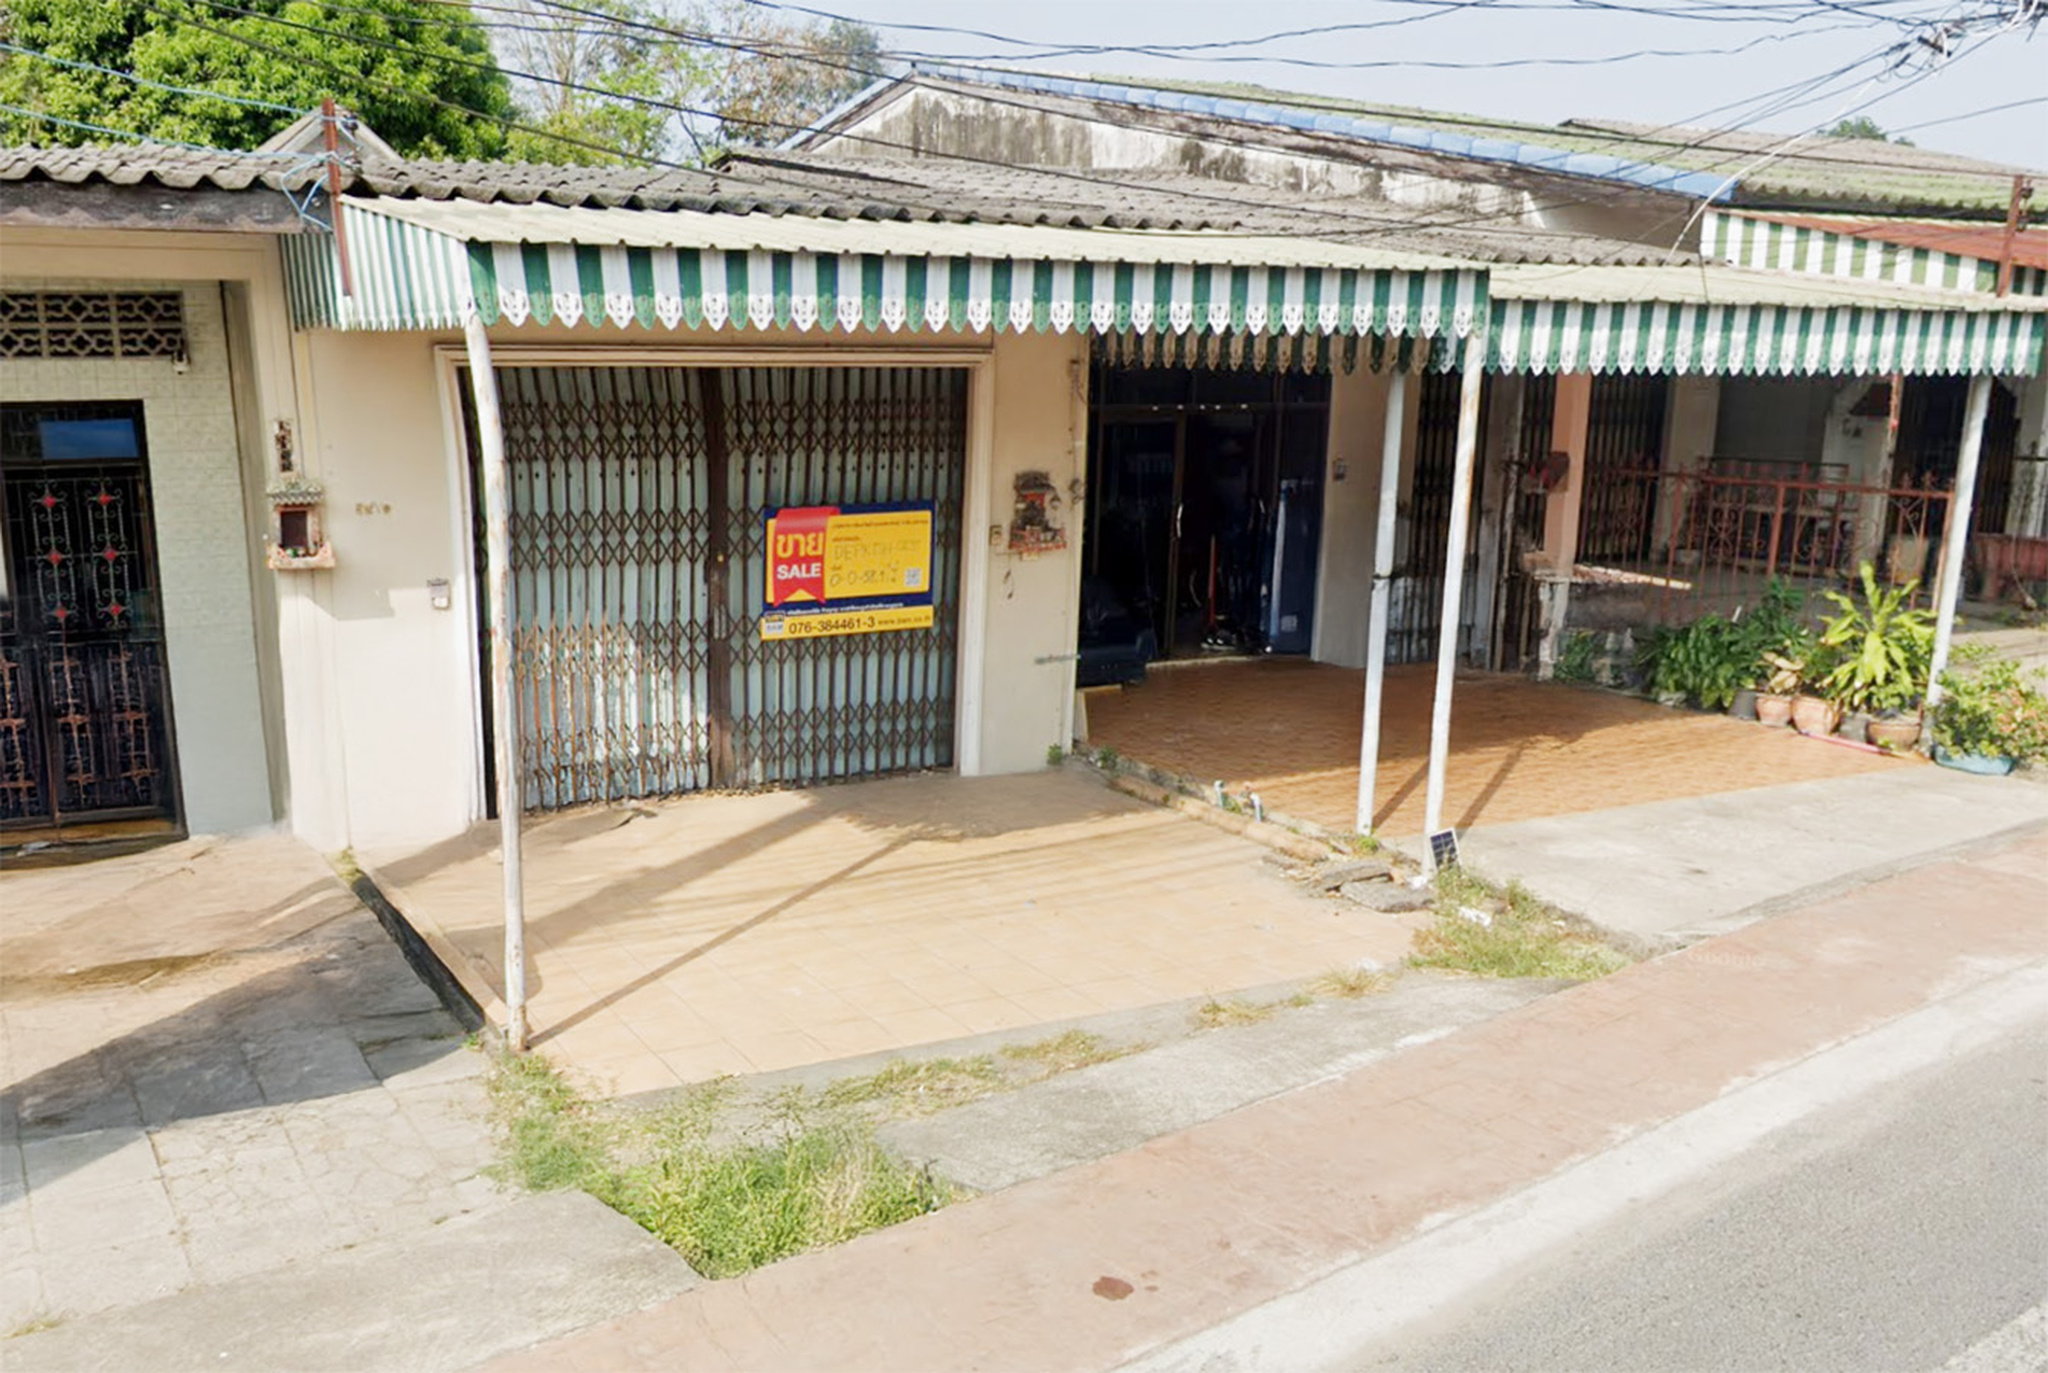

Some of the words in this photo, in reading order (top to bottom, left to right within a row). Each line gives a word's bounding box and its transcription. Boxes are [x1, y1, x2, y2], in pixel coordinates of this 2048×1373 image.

[776, 532, 823, 558] ขาย
[776, 563, 822, 580] SALE
[788, 616, 876, 635] 076-384461-3
